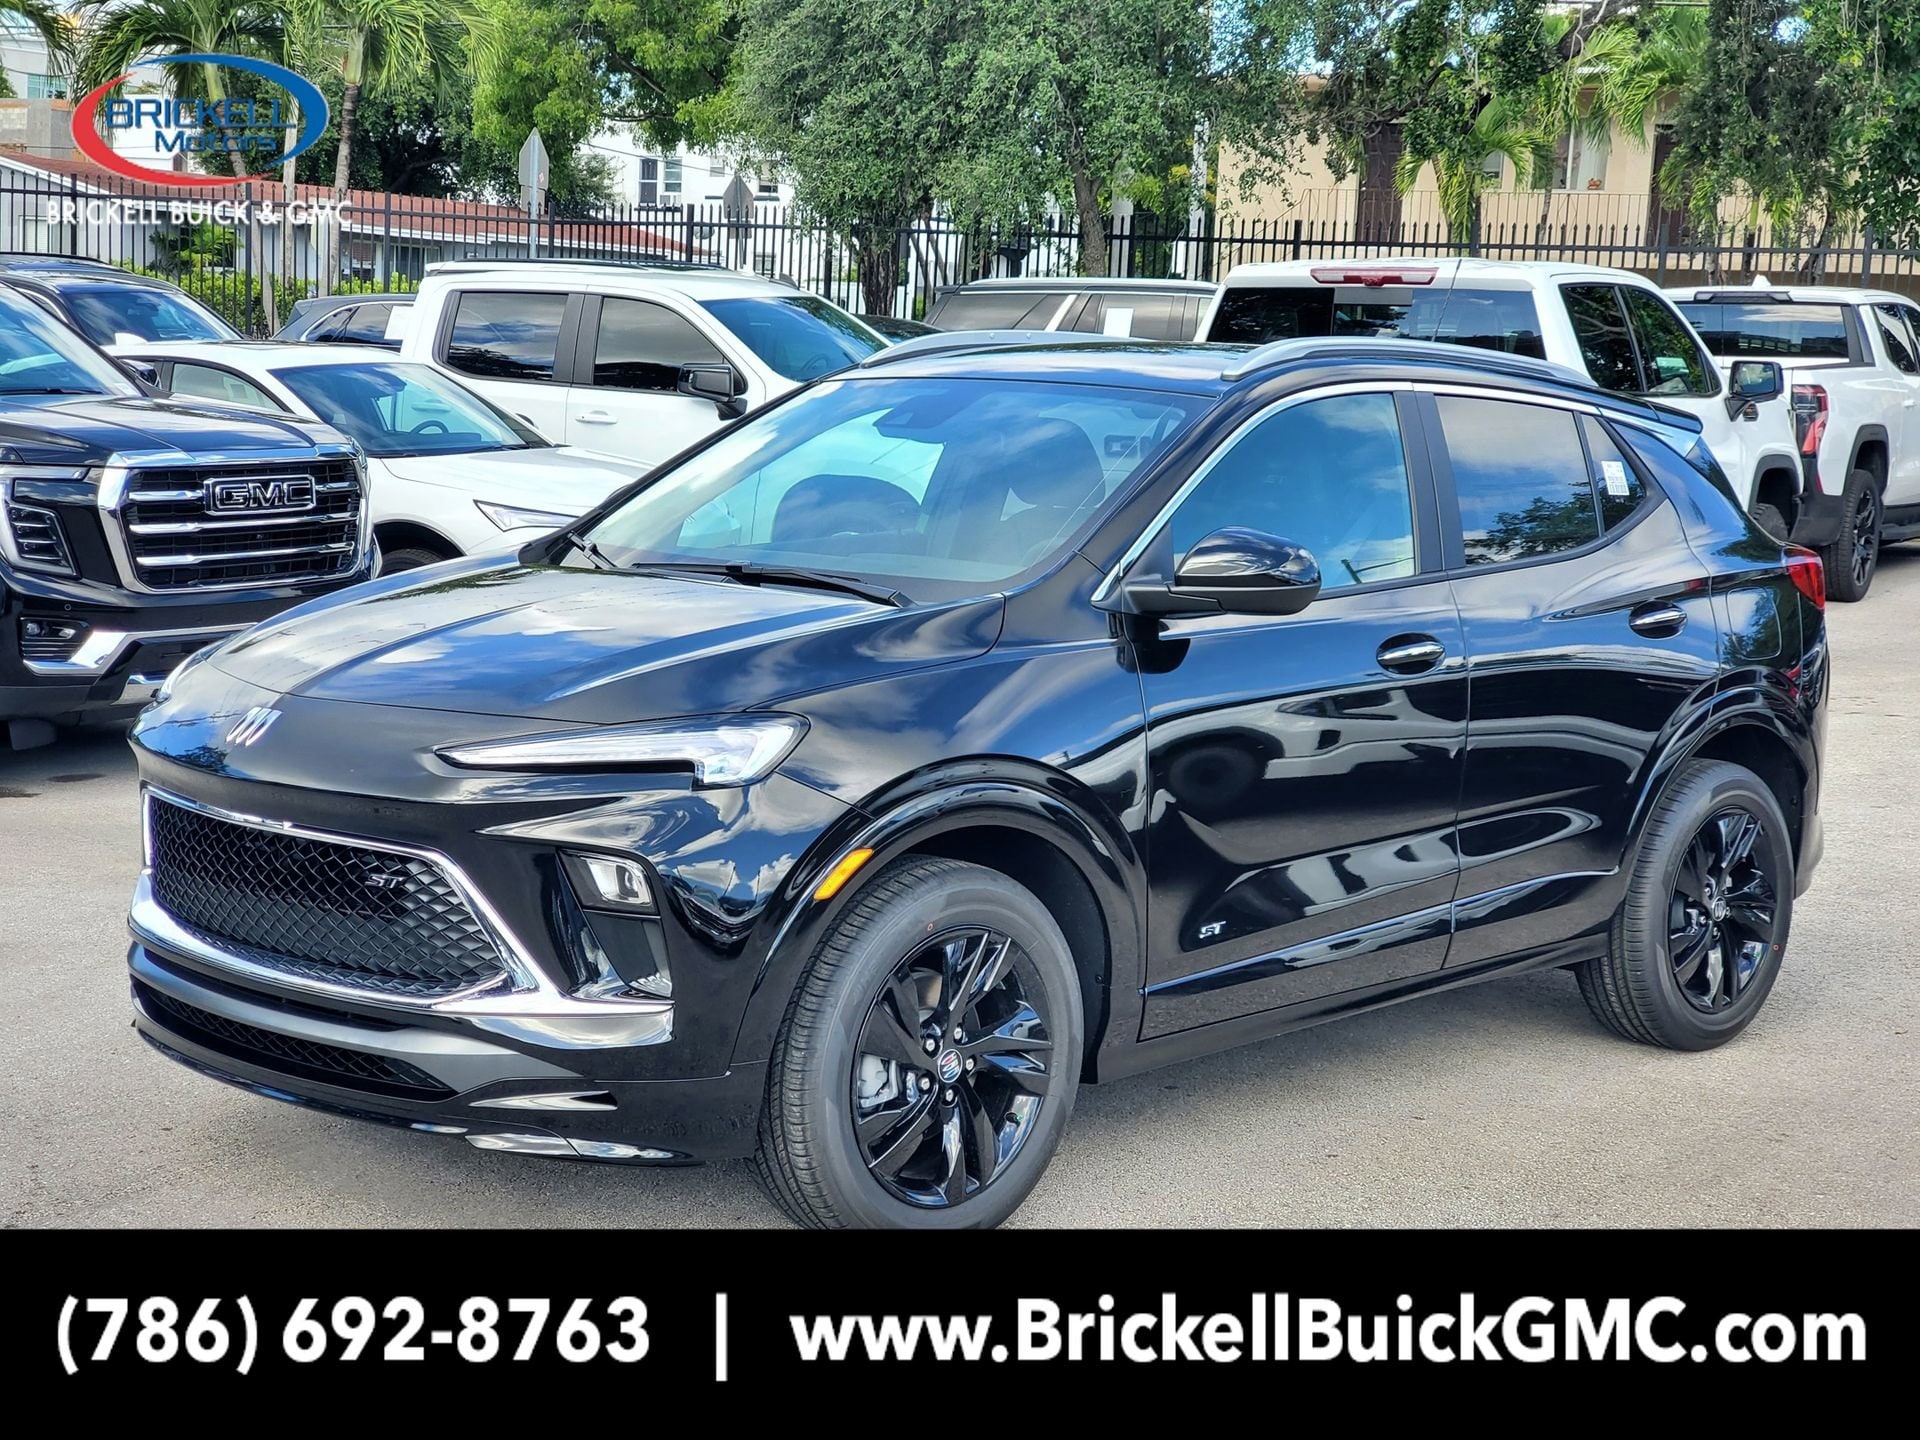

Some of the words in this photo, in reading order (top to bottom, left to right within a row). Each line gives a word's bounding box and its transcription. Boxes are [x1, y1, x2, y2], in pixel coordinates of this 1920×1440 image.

[215, 481, 312, 509] GMC
[364, 873, 407, 889] ST
[1198, 920, 1227, 939] ST
